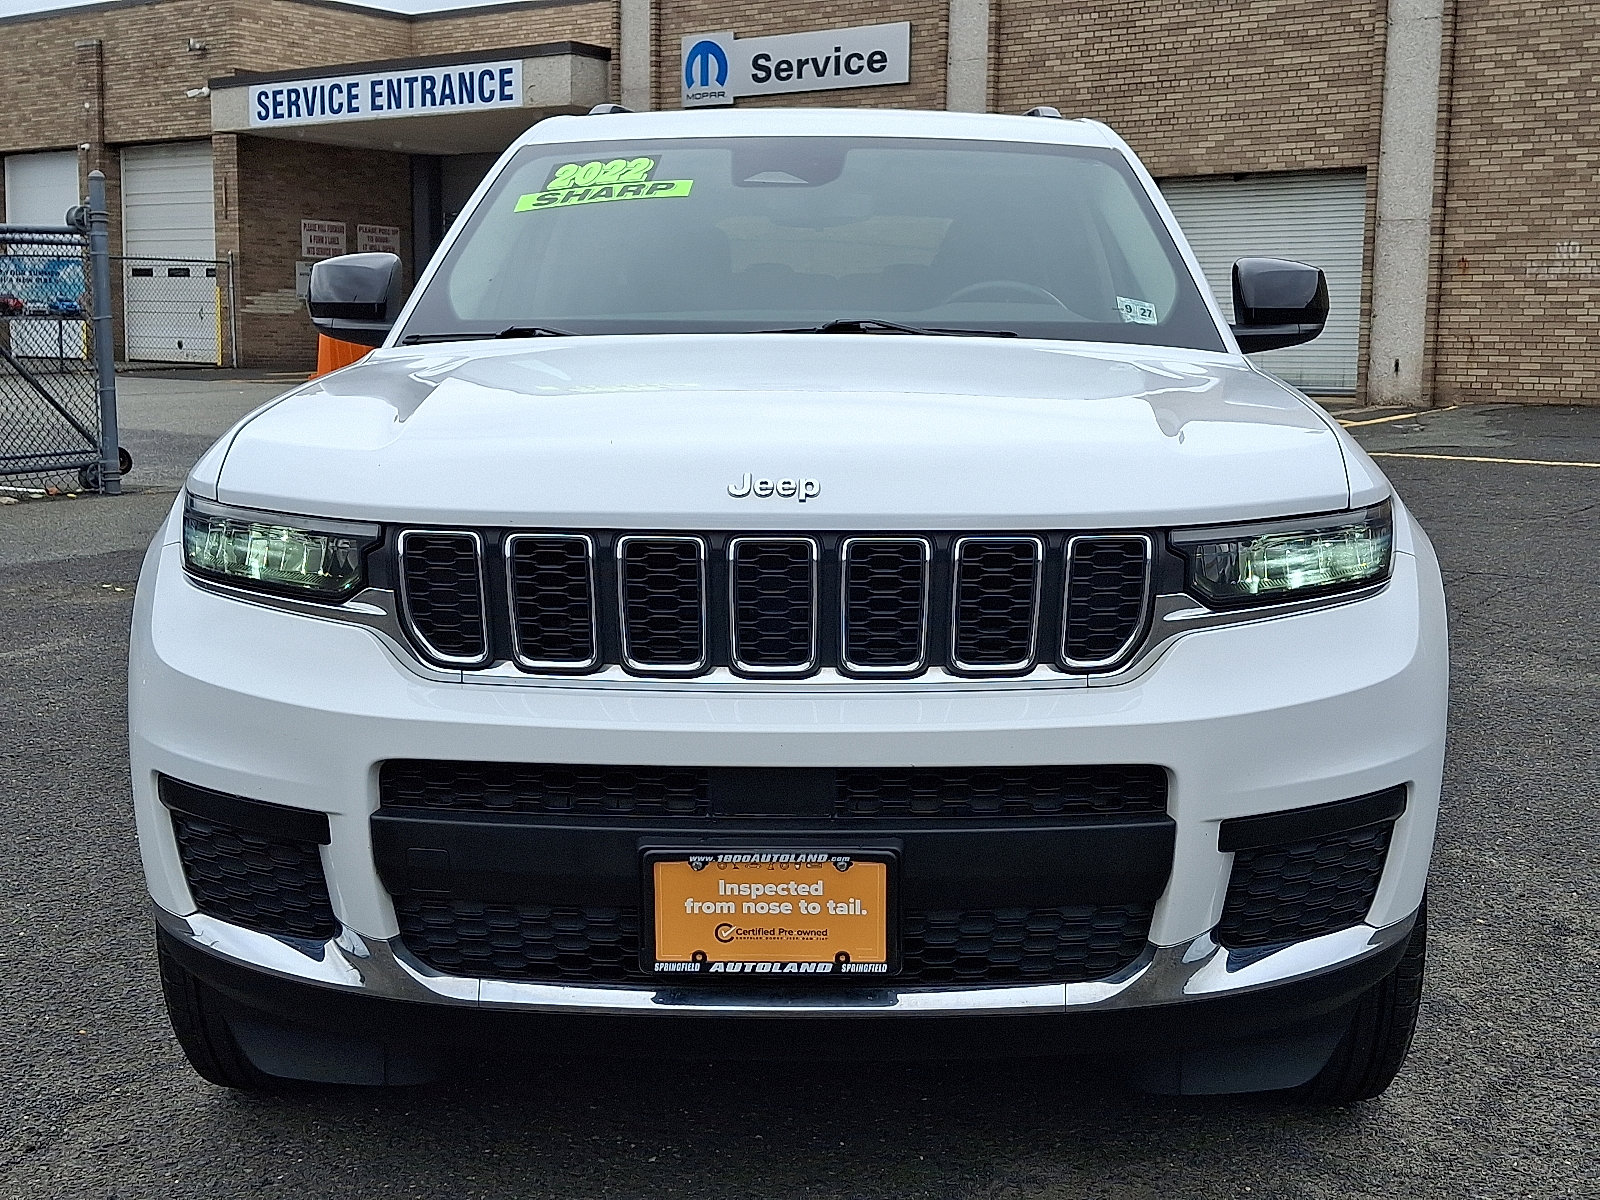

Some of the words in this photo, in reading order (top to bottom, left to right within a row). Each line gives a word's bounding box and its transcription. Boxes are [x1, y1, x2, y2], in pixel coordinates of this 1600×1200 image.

[751, 46, 888, 84] Service
[256, 82, 360, 121] SERVICE
[370, 67, 514, 111] ENTRANCE
[686, 91, 726, 100] MOPAR
[547, 157, 655, 191] 2022
[532, 182, 676, 207] SHARP
[1125, 304, 1133, 314] 9
[1140, 307, 1152, 317] 27
[727, 472, 821, 503] Jeep
[718, 879, 824, 899] Inspected
[684, 898, 736, 914] from
[742, 901, 793, 915] nose
[798, 899, 821, 915] to
[827, 897, 868, 916] tail.
[736, 927, 775, 936] Certified
[654, 962, 701, 972] SPRINGFIELD
[709, 961, 833, 973] AUTOLAND
[841, 963, 888, 973] SPRINGFIELD
